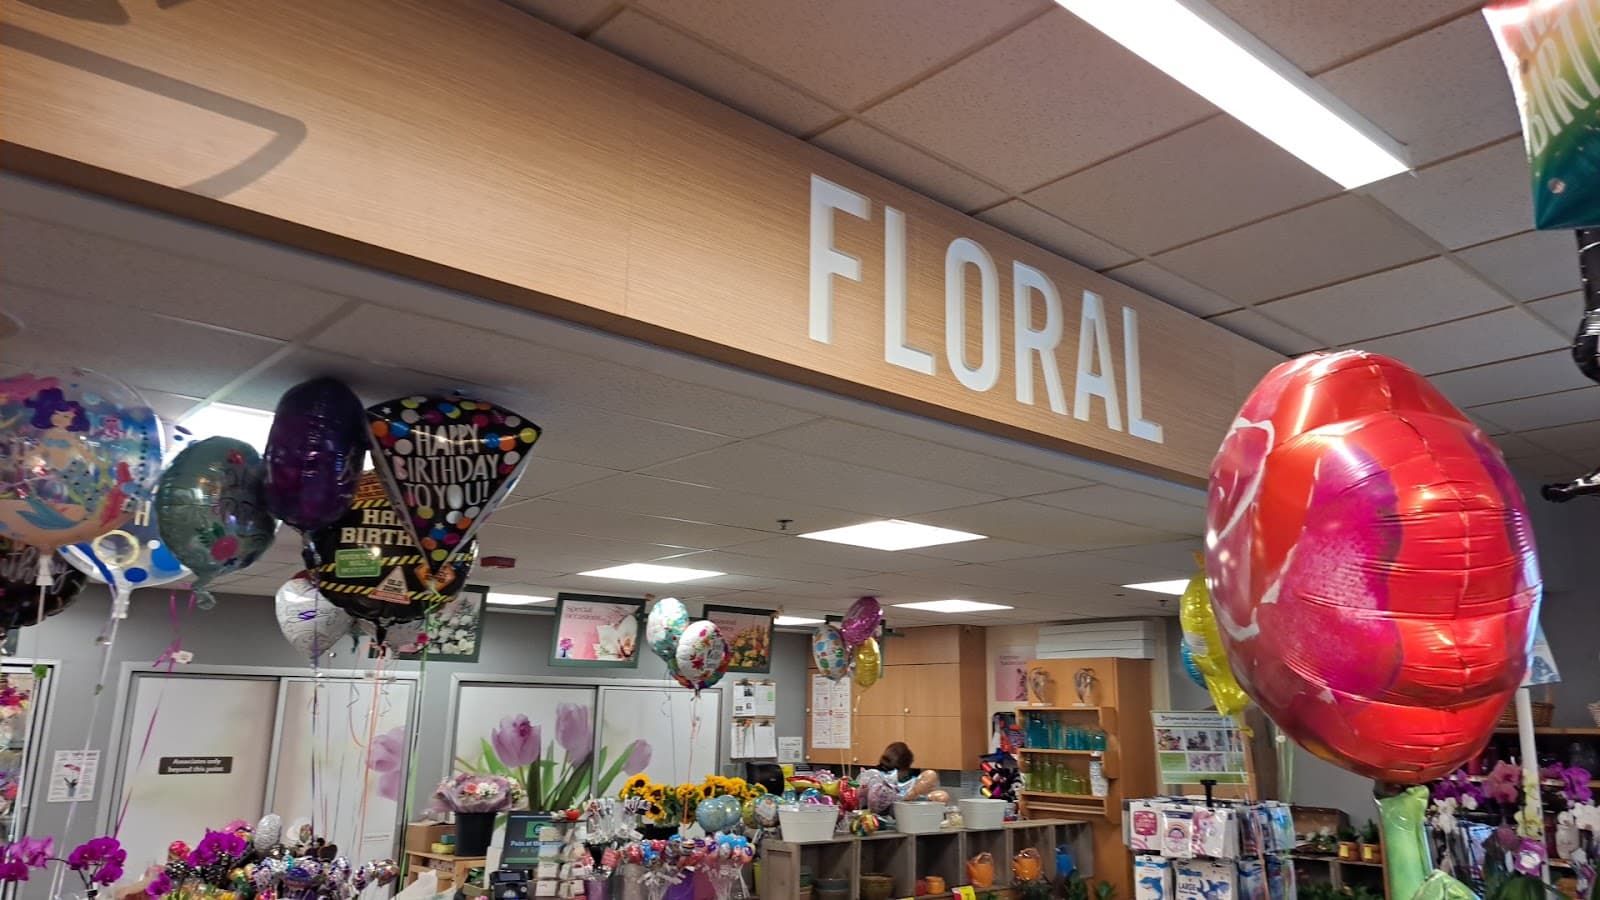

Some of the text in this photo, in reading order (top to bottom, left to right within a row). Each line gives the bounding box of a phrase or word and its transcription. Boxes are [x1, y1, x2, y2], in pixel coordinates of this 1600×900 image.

[809, 173, 1163, 443] FLORAL
[415, 424, 479, 456] HAPPY
[393, 454, 499, 482] BIRTHDAY
[403, 481, 490, 510] TO YOU!
[205, 766, 225, 774] point
